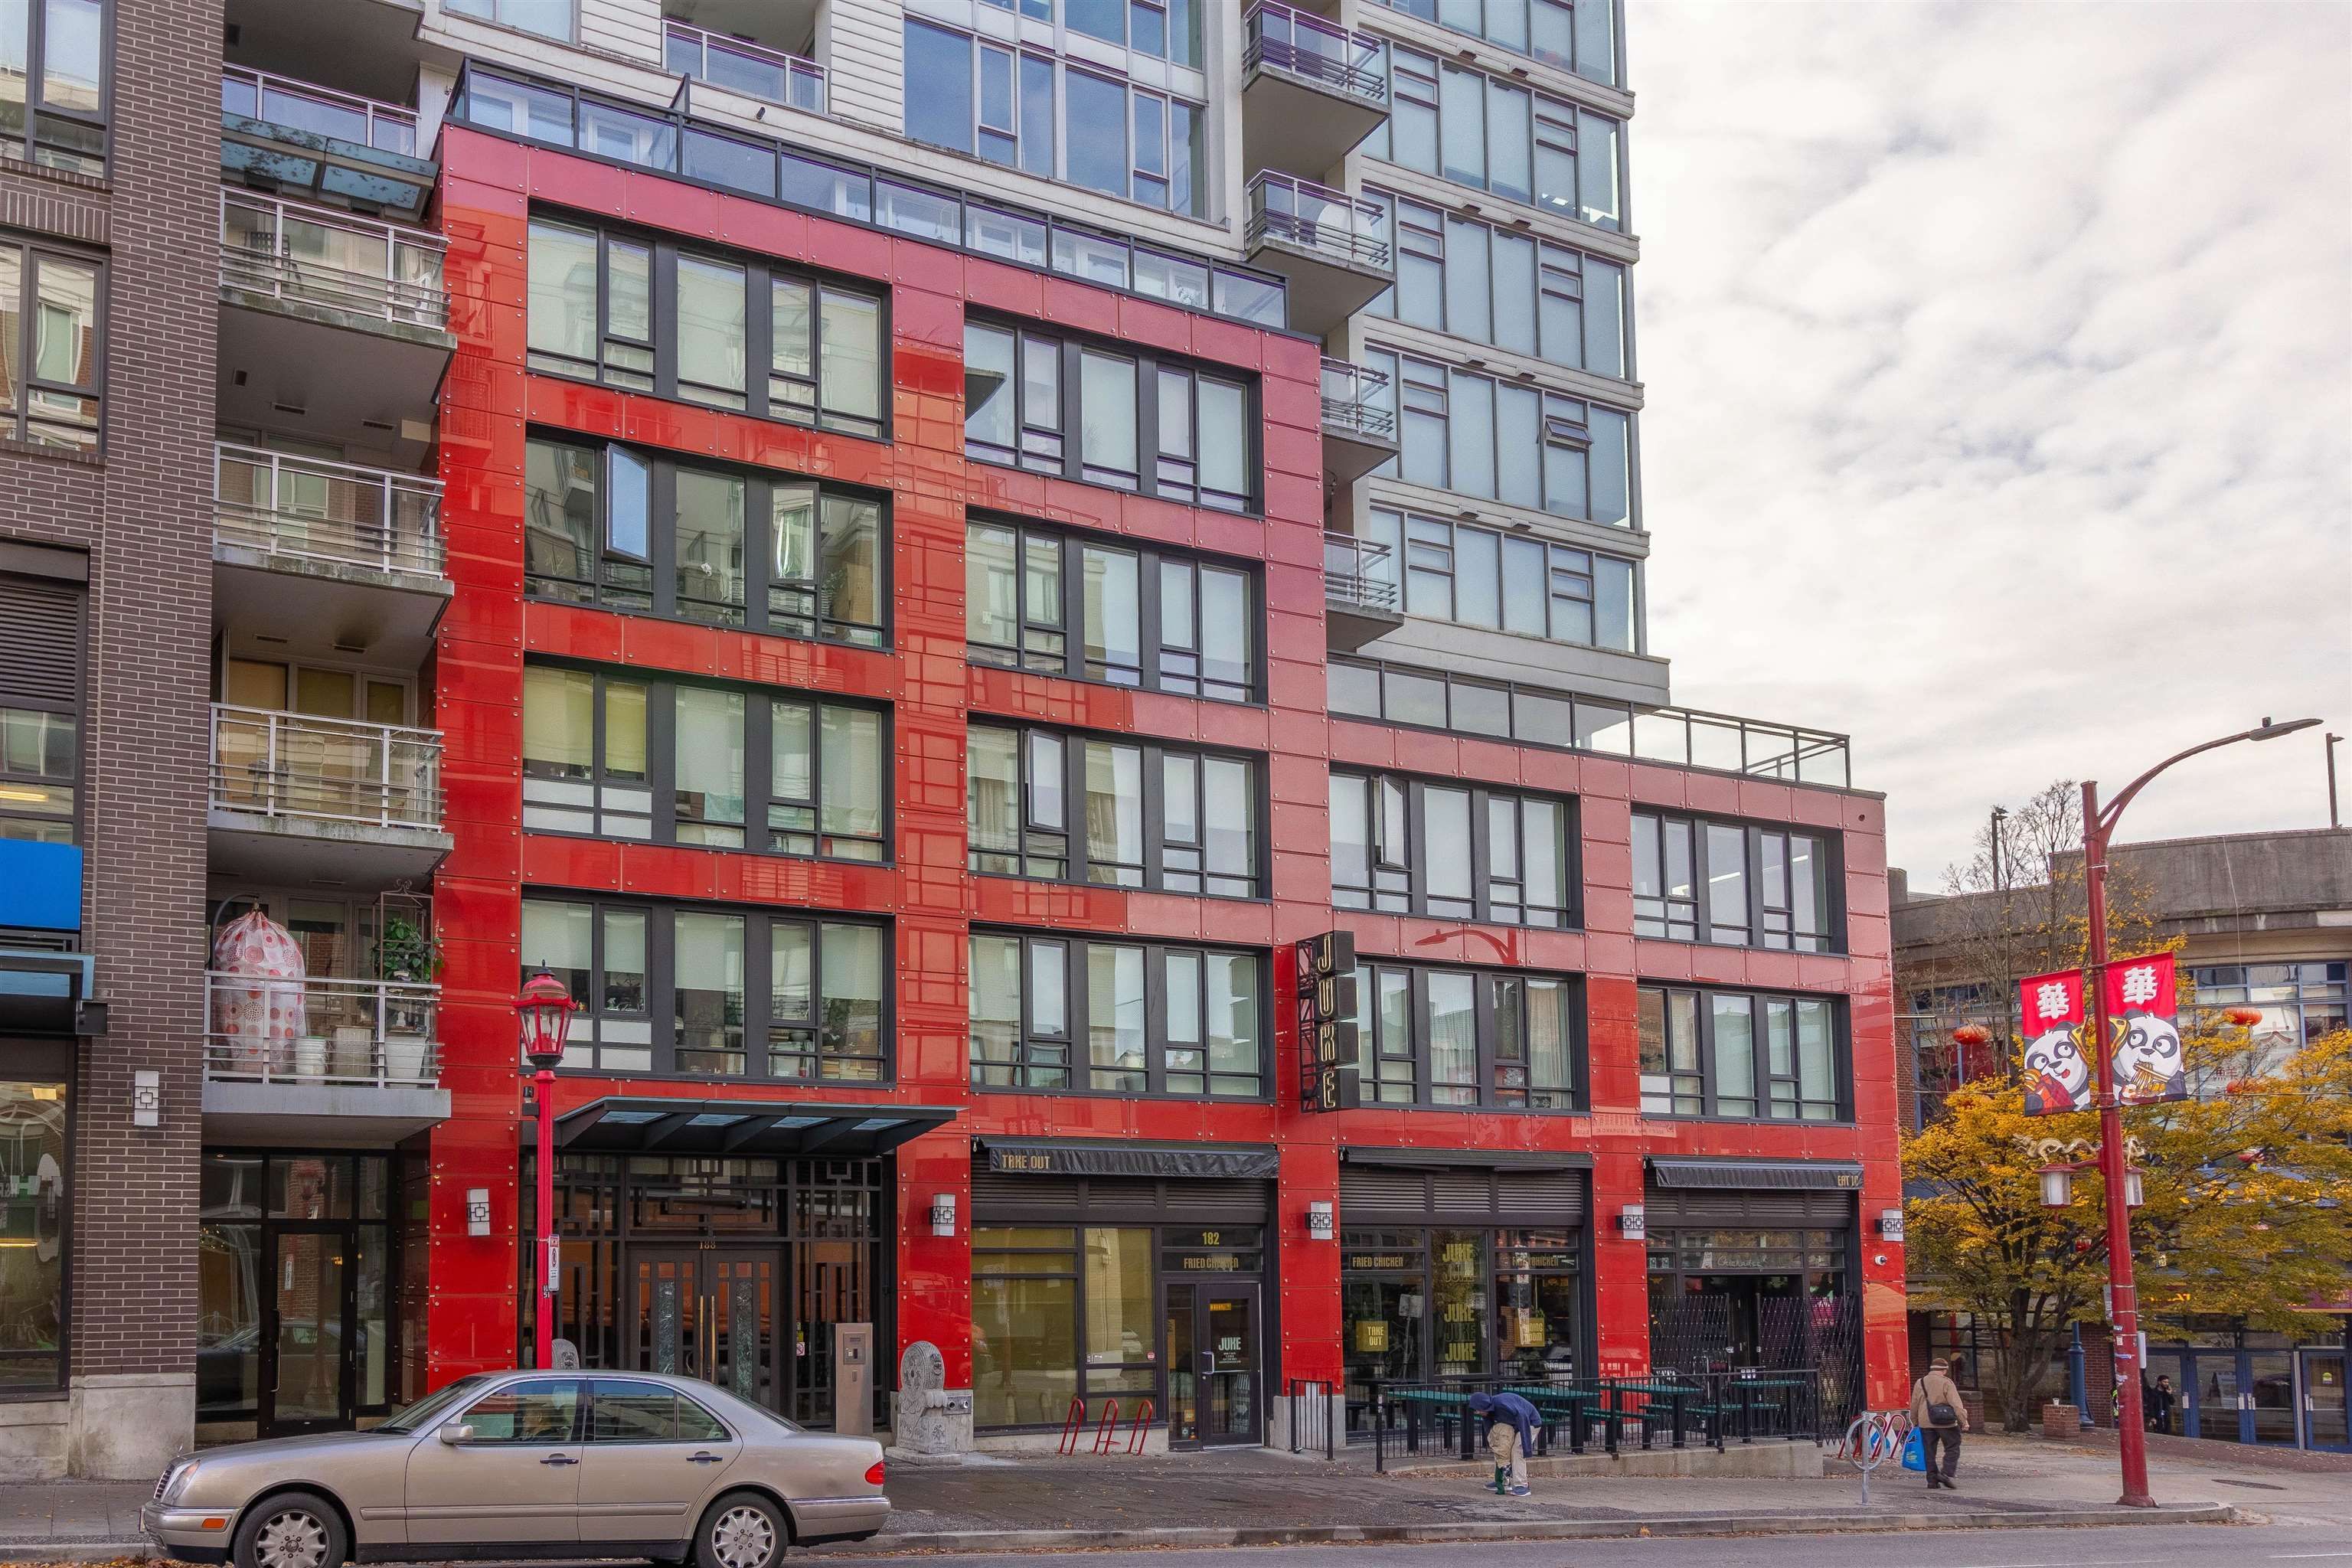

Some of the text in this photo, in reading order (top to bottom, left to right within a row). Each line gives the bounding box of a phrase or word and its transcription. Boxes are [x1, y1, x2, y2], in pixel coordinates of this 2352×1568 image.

[2122, 965, 2158, 1004] 華
[2037, 982, 2070, 1020] 華
[1317, 933, 1335, 1108] JUKE
[1001, 1155, 1050, 1169] TAKE OUT
[1838, 1175, 1850, 1186] EAT
[1202, 1232, 1220, 1245] 182
[1442, 1243, 1474, 1263] JUKE
[1184, 1257, 1205, 1269] FRIED
[1352, 1256, 1403, 1267] FRIED CHICKEN
[1444, 1304, 1475, 1323] JUKE
[1367, 1326, 1384, 1336] TAKE
[1218, 1337, 1241, 1351] JUKE
[1369, 1336, 1383, 1346] OUT
[1445, 1343, 1476, 1361] JUKE
